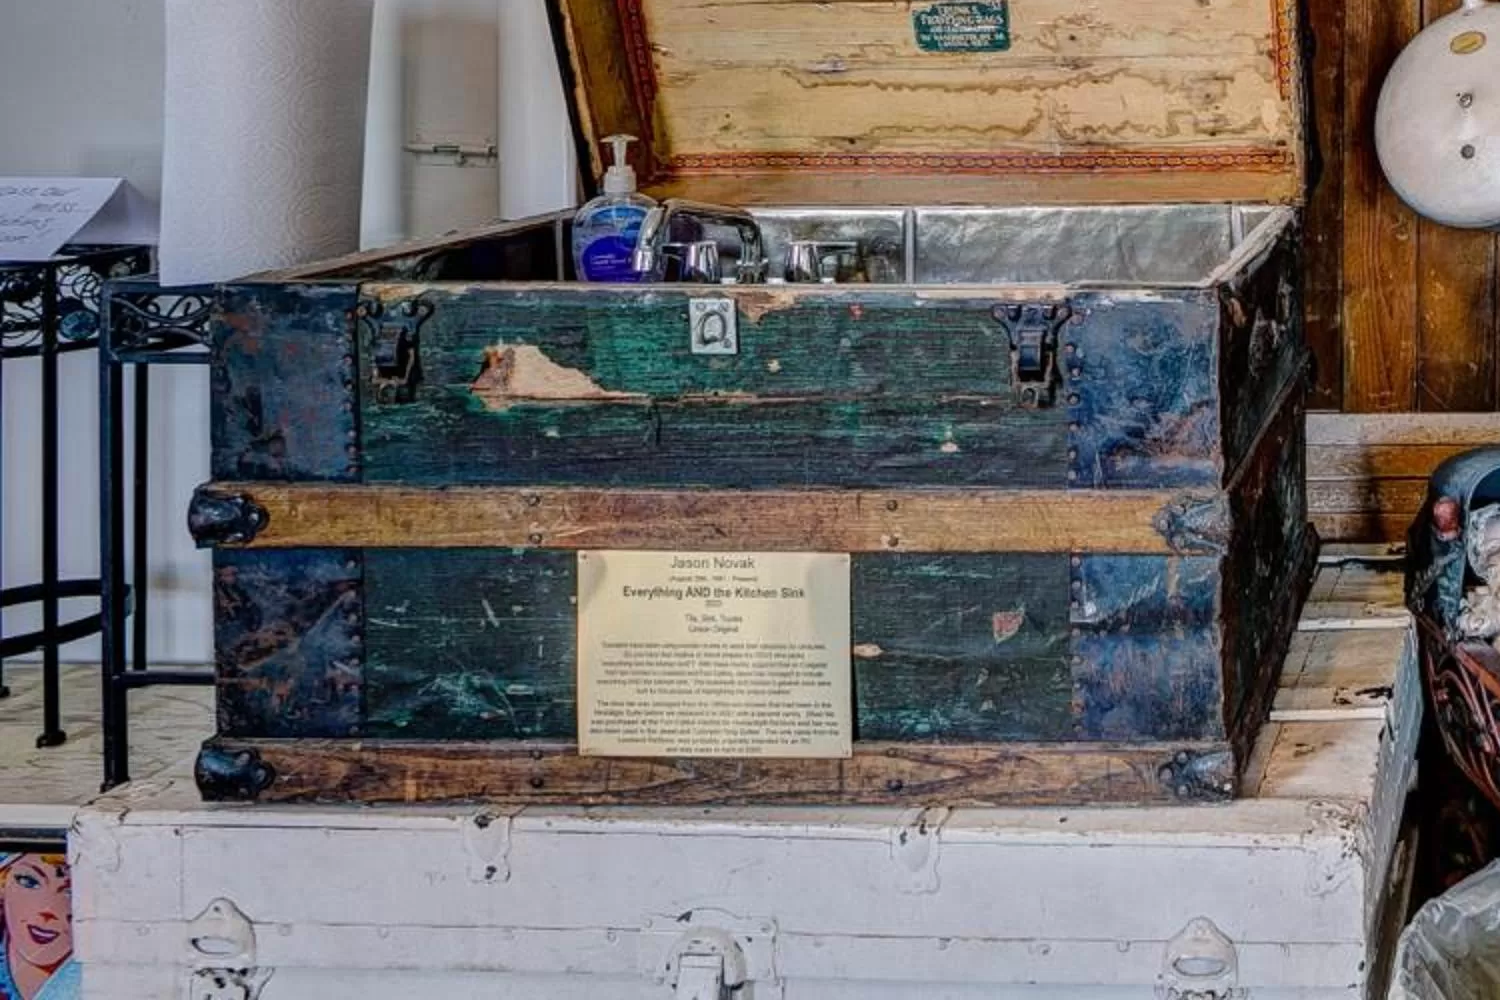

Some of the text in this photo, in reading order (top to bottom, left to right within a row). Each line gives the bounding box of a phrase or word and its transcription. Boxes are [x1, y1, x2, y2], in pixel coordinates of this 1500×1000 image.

[670, 555, 755, 569] Jason Novak
[622, 585, 806, 600] Everything AND the Kitchen Sink
